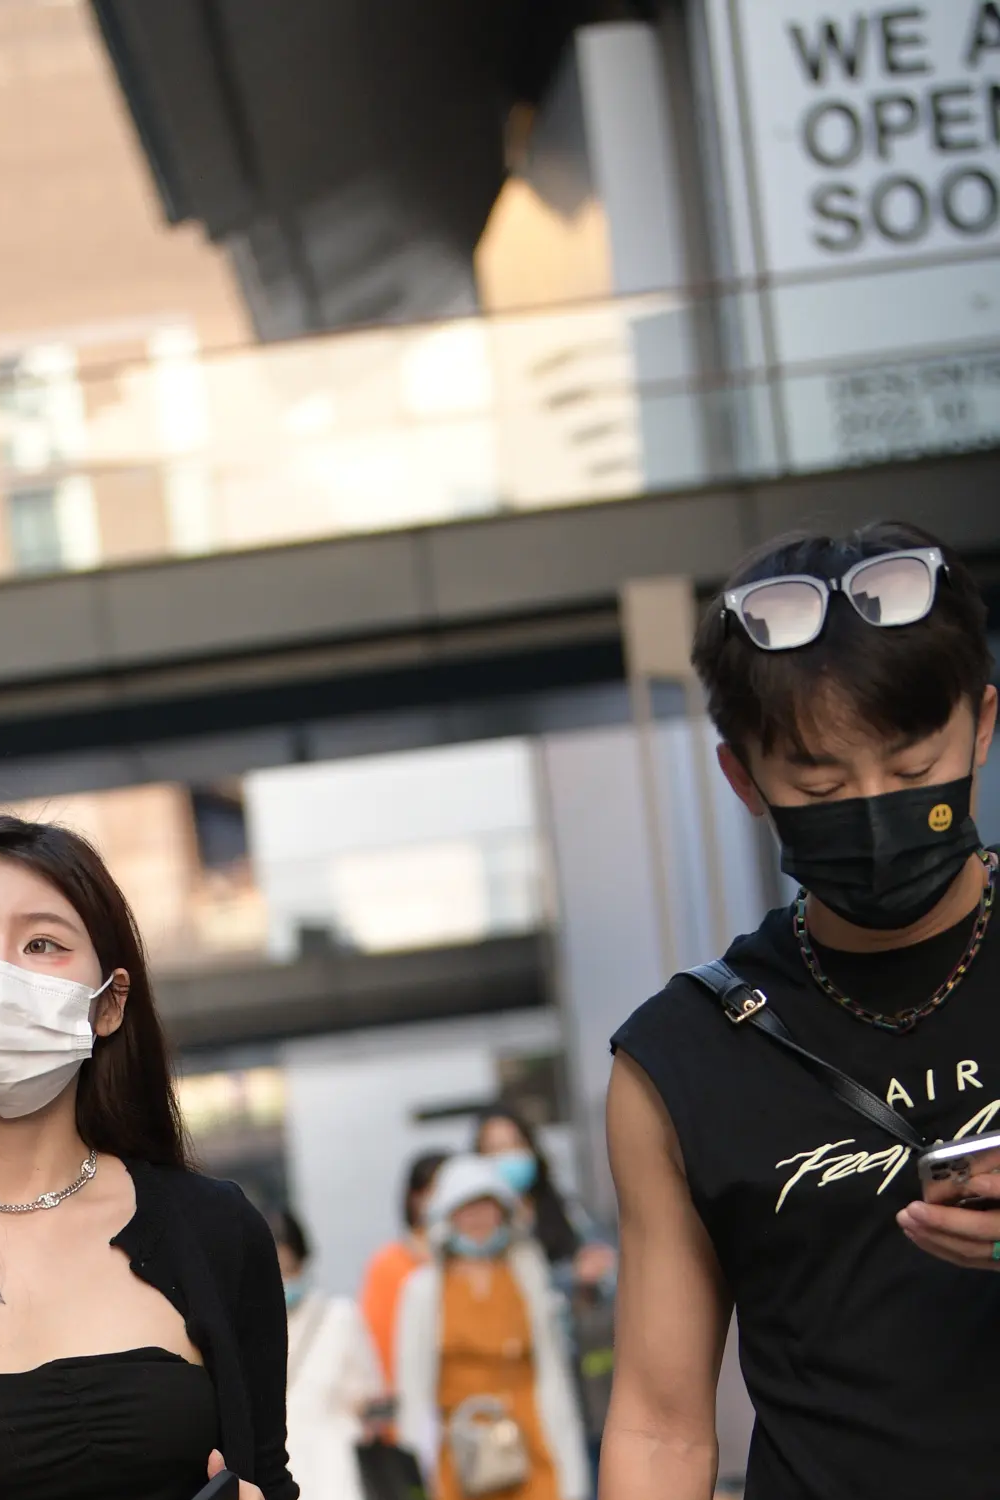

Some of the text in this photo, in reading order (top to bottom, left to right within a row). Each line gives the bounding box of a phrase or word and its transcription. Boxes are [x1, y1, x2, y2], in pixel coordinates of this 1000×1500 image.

[789, 8, 934, 84] WE
[810, 165, 1000, 254] SOO
[886, 1059, 984, 1109] AIR
